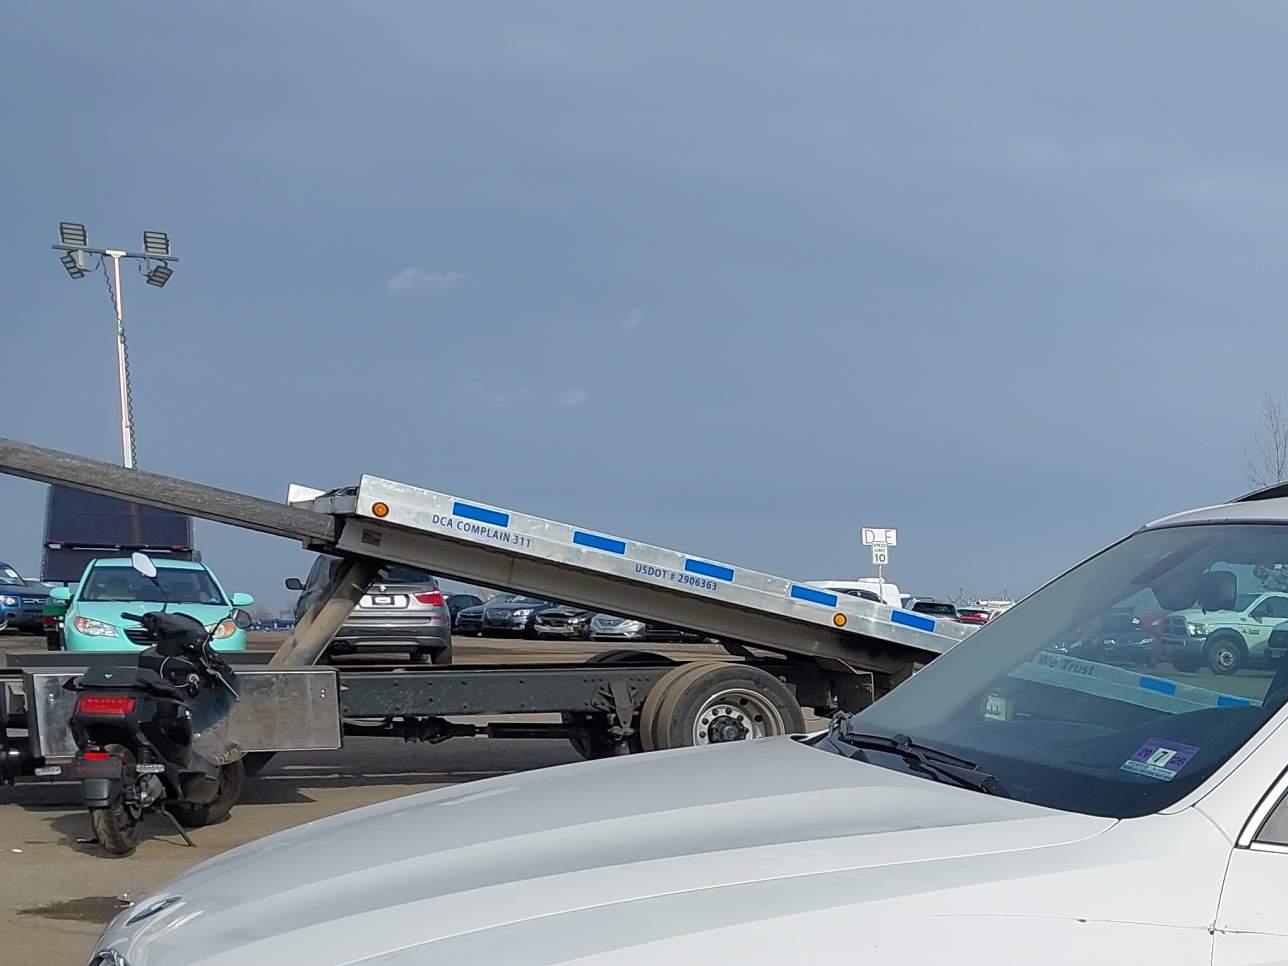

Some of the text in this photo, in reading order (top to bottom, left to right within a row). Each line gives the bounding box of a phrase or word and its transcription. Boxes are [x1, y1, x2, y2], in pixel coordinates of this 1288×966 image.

[432, 514, 453, 529] DCA
[512, 535, 531, 548] 311
[875, 553, 886, 563] 10
[635, 563, 667, 579] USDOT
[678, 574, 718, 591] 2906363
[1038, 654, 1095, 676] We Trust
[1154, 750, 1169, 763] 7
